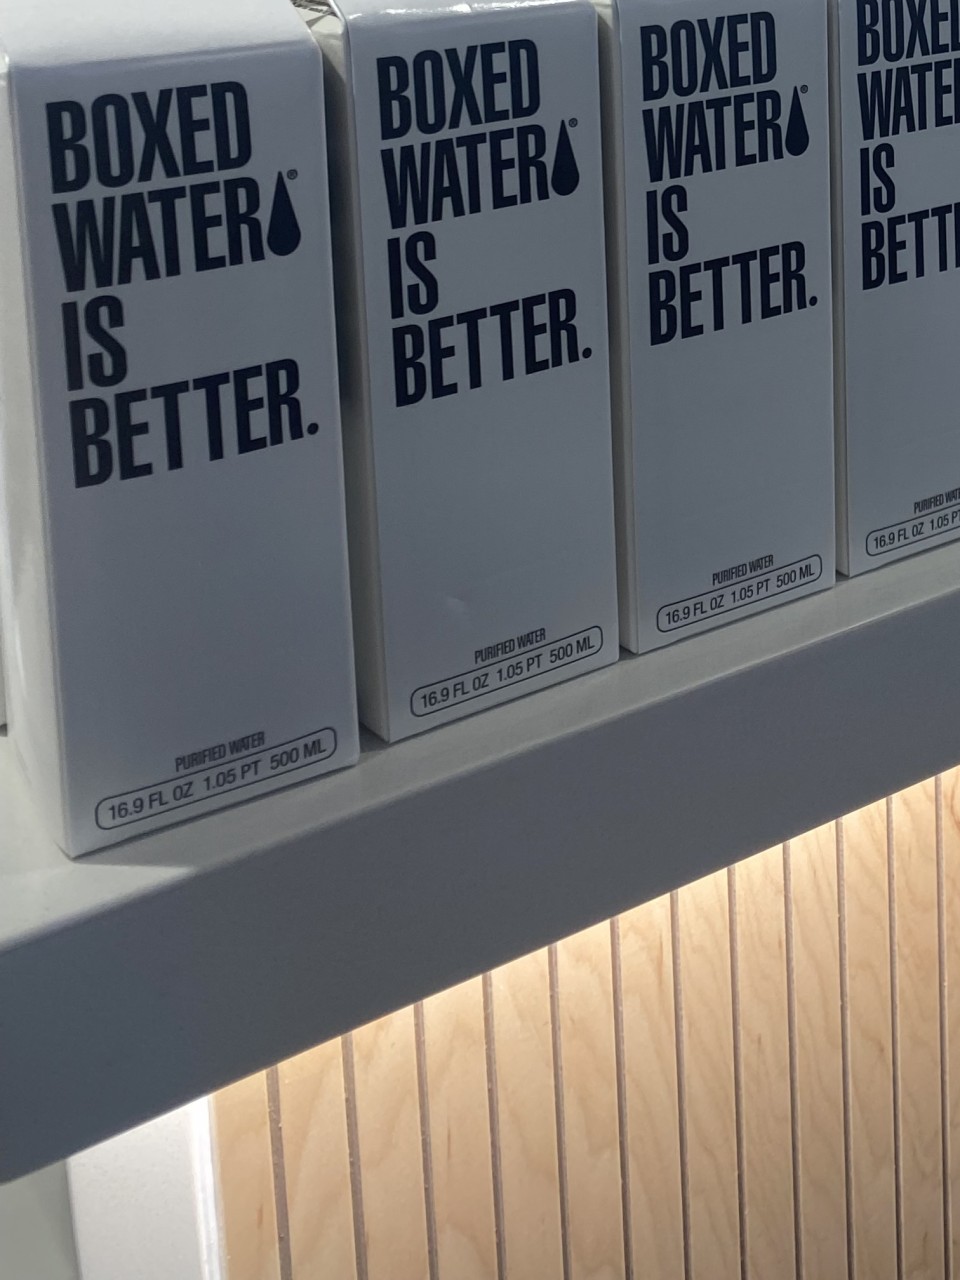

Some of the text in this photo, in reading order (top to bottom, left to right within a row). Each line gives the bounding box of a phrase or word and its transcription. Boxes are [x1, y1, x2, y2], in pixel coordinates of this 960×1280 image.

[377, 39, 540, 140] BOXED
[640, 11, 776, 101] BOXED
[46, 81, 251, 193] BOXED
[380, 124, 550, 228] WATER
[642, 89, 784, 182] WATER
[860, 143, 895, 216] IS
[52, 176, 265, 292] WATER
[646, 185, 688, 264] IS
[387, 231, 438, 318] IS
[648, 240, 817, 346] BETTER.
[61, 295, 127, 391] IS
[392, 288, 591, 407] BETTER.
[69, 358, 319, 488] BETTER.
[874, 532, 895, 549] 16.9
[898, 528, 909, 542] FL
[912, 522, 924, 537] OZ
[930, 514, 949, 531] 1.05
[914, 494, 944, 514] PURIFIED
[666, 563, 815, 625] 16.9 FL OZ 1.05 PT 500 ML
[712, 555, 773, 586] PURIFIED WATER
[421, 636, 595, 708] 16.9 FL OZ 1.05 PT 500 ML
[474, 628, 546, 664] PURIFIED WATER
[108, 738, 327, 820] 16.9 FL OZ 1.05 PT 500 ML
[175, 731, 264, 772] PURIFIED WATER
